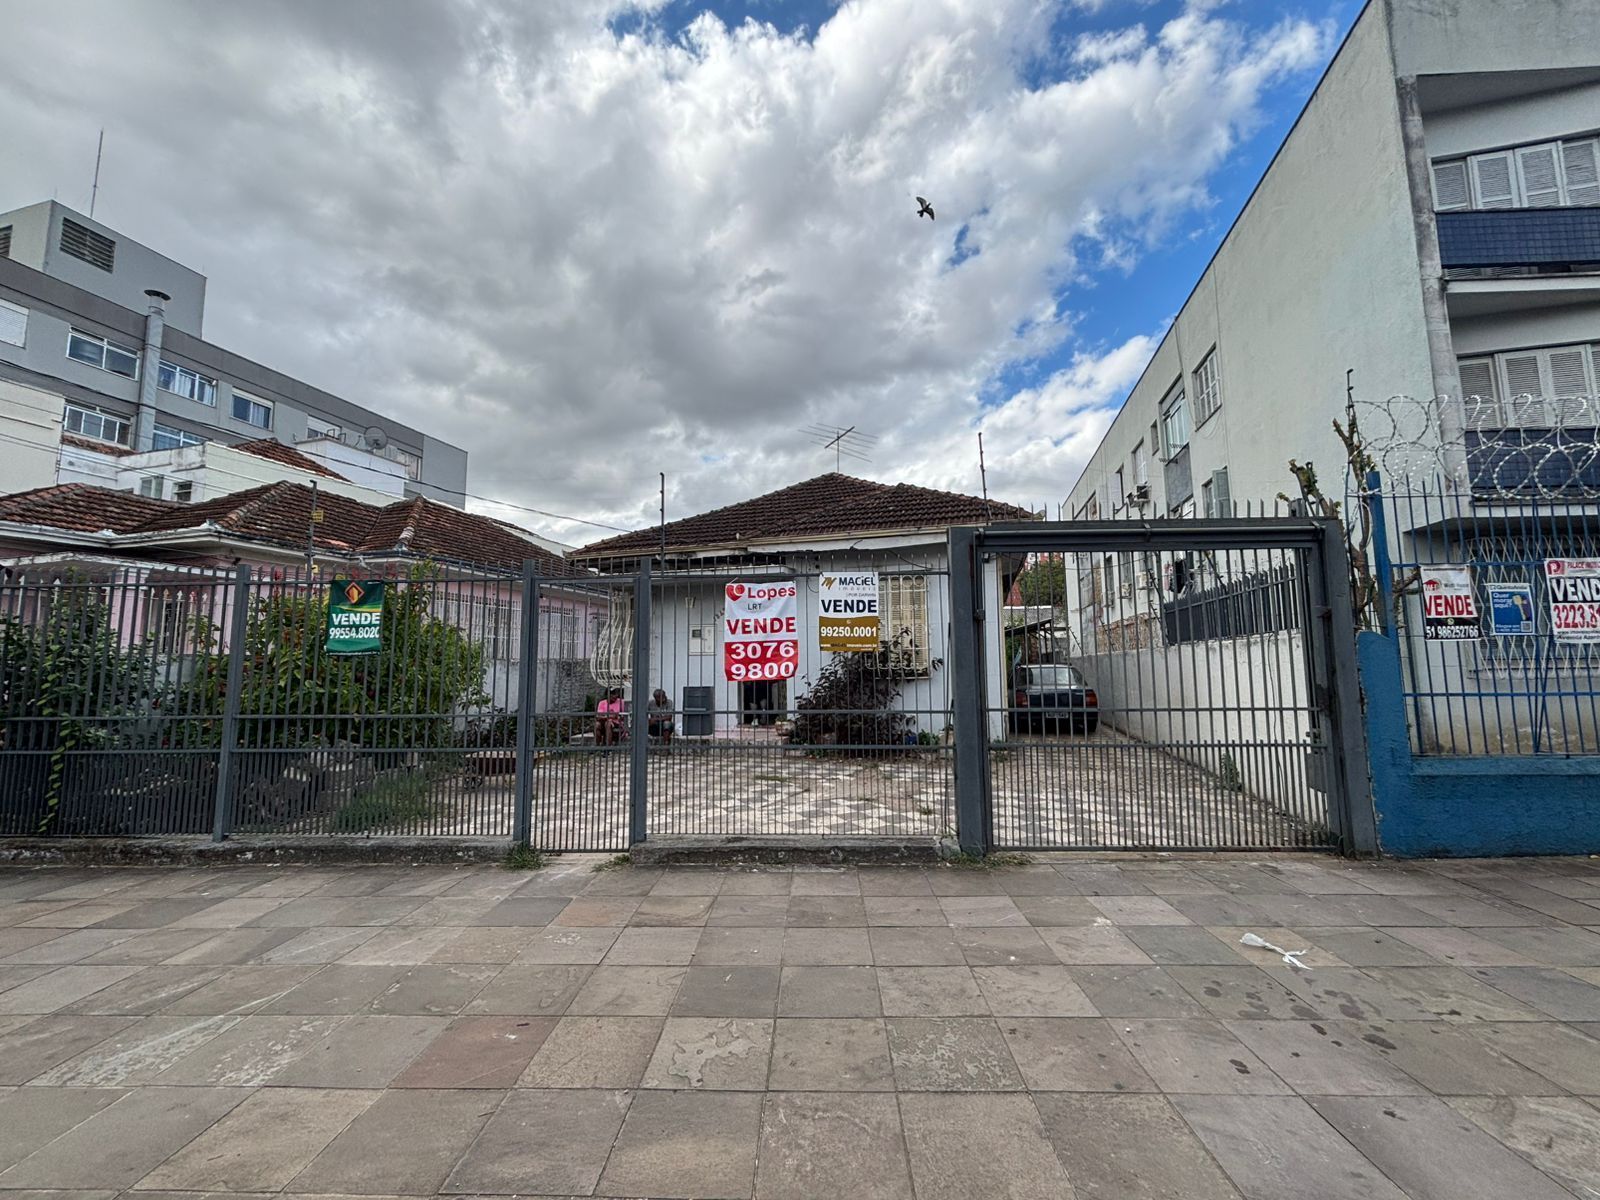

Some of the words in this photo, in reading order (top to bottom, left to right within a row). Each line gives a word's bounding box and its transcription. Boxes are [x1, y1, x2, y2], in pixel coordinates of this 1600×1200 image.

[747, 586, 796, 600] Lopes
[821, 599, 877, 613] VENDE
[1426, 595, 1473, 616] VENDE
[332, 612, 381, 625] VENDE
[726, 616, 796, 635] VENDE
[820, 626, 877, 637] 99250.0001
[1426, 626, 1435, 638] 51
[730, 641, 795, 660] 3076
[730, 661, 795, 680] 9800
